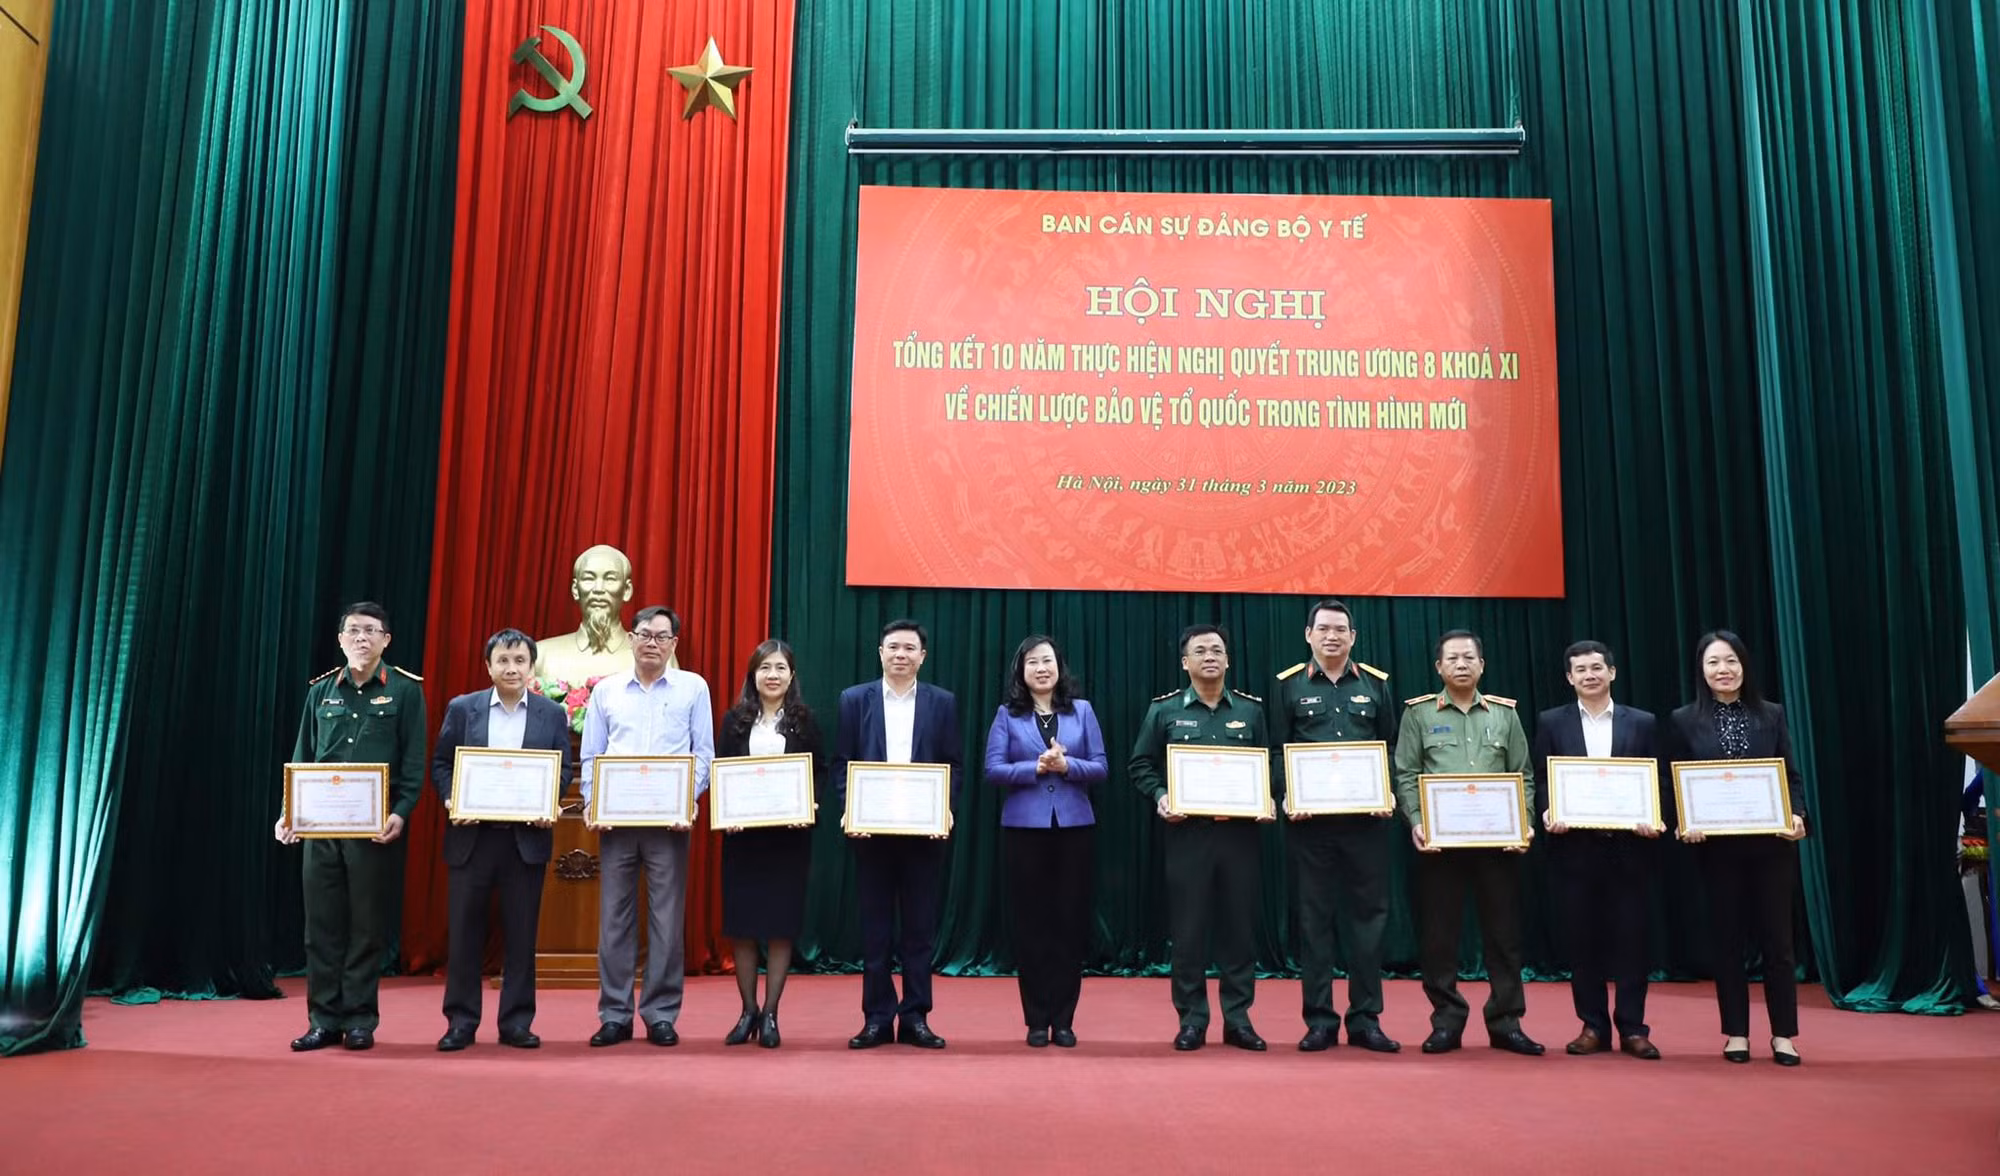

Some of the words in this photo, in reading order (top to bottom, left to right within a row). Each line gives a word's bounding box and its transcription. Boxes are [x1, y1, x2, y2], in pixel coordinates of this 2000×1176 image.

[1042, 213, 1092, 233] BAN
[1098, 211, 1153, 235] CÁN
[1160, 214, 1191, 241] SỰ
[1197, 211, 1270, 238] ĐẢNG
[1277, 214, 1312, 244] BỘ
[1318, 220, 1333, 239] Y
[1340, 212, 1368, 239] TẾ
[1085, 276, 1179, 325] HỘI
[1194, 288, 1326, 329] NGHỊ
[893, 330, 944, 369] TỔNG
[949, 333, 985, 370] KẾT
[991, 343, 1014, 371] 10
[1020, 337, 1065, 372] NĂM
[1071, 342, 1121, 378] THỰC
[1126, 340, 1172, 379] HIỆN
[1178, 346, 1224, 381] NGHỊ
[1230, 340, 1290, 378] QUYẾT
[1295, 348, 1359, 378] TRUNG
[1365, 347, 1419, 379] ƯƠNG
[1423, 351, 1436, 379] 8
[1441, 346, 1493, 380] KHOÁ
[1499, 352, 1519, 380] XI
[945, 384, 969, 421] VỀ
[974, 385, 1033, 422] CHIẾN
[1039, 392, 1089, 430] LƯỢC
[1094, 386, 1134, 425] BẢO
[1140, 391, 1163, 431] VỆ
[1169, 386, 1194, 426] TỔ
[1199, 389, 1251, 429] QUỐC
[1256, 398, 1320, 429] TRONG
[1326, 395, 1371, 429] TÌNH
[1376, 395, 1424, 430] HÌNH
[1429, 396, 1468, 431] MỚI
[1056, 475, 1083, 491] Hà
[1088, 475, 1124, 493] Nội,
[1129, 477, 1172, 494] ngày
[1176, 478, 1197, 493] 31
[1202, 478, 1251, 496] tháng
[1257, 479, 1267, 493] 3
[1272, 480, 1311, 495] năm
[1315, 480, 1357, 496] 2023
